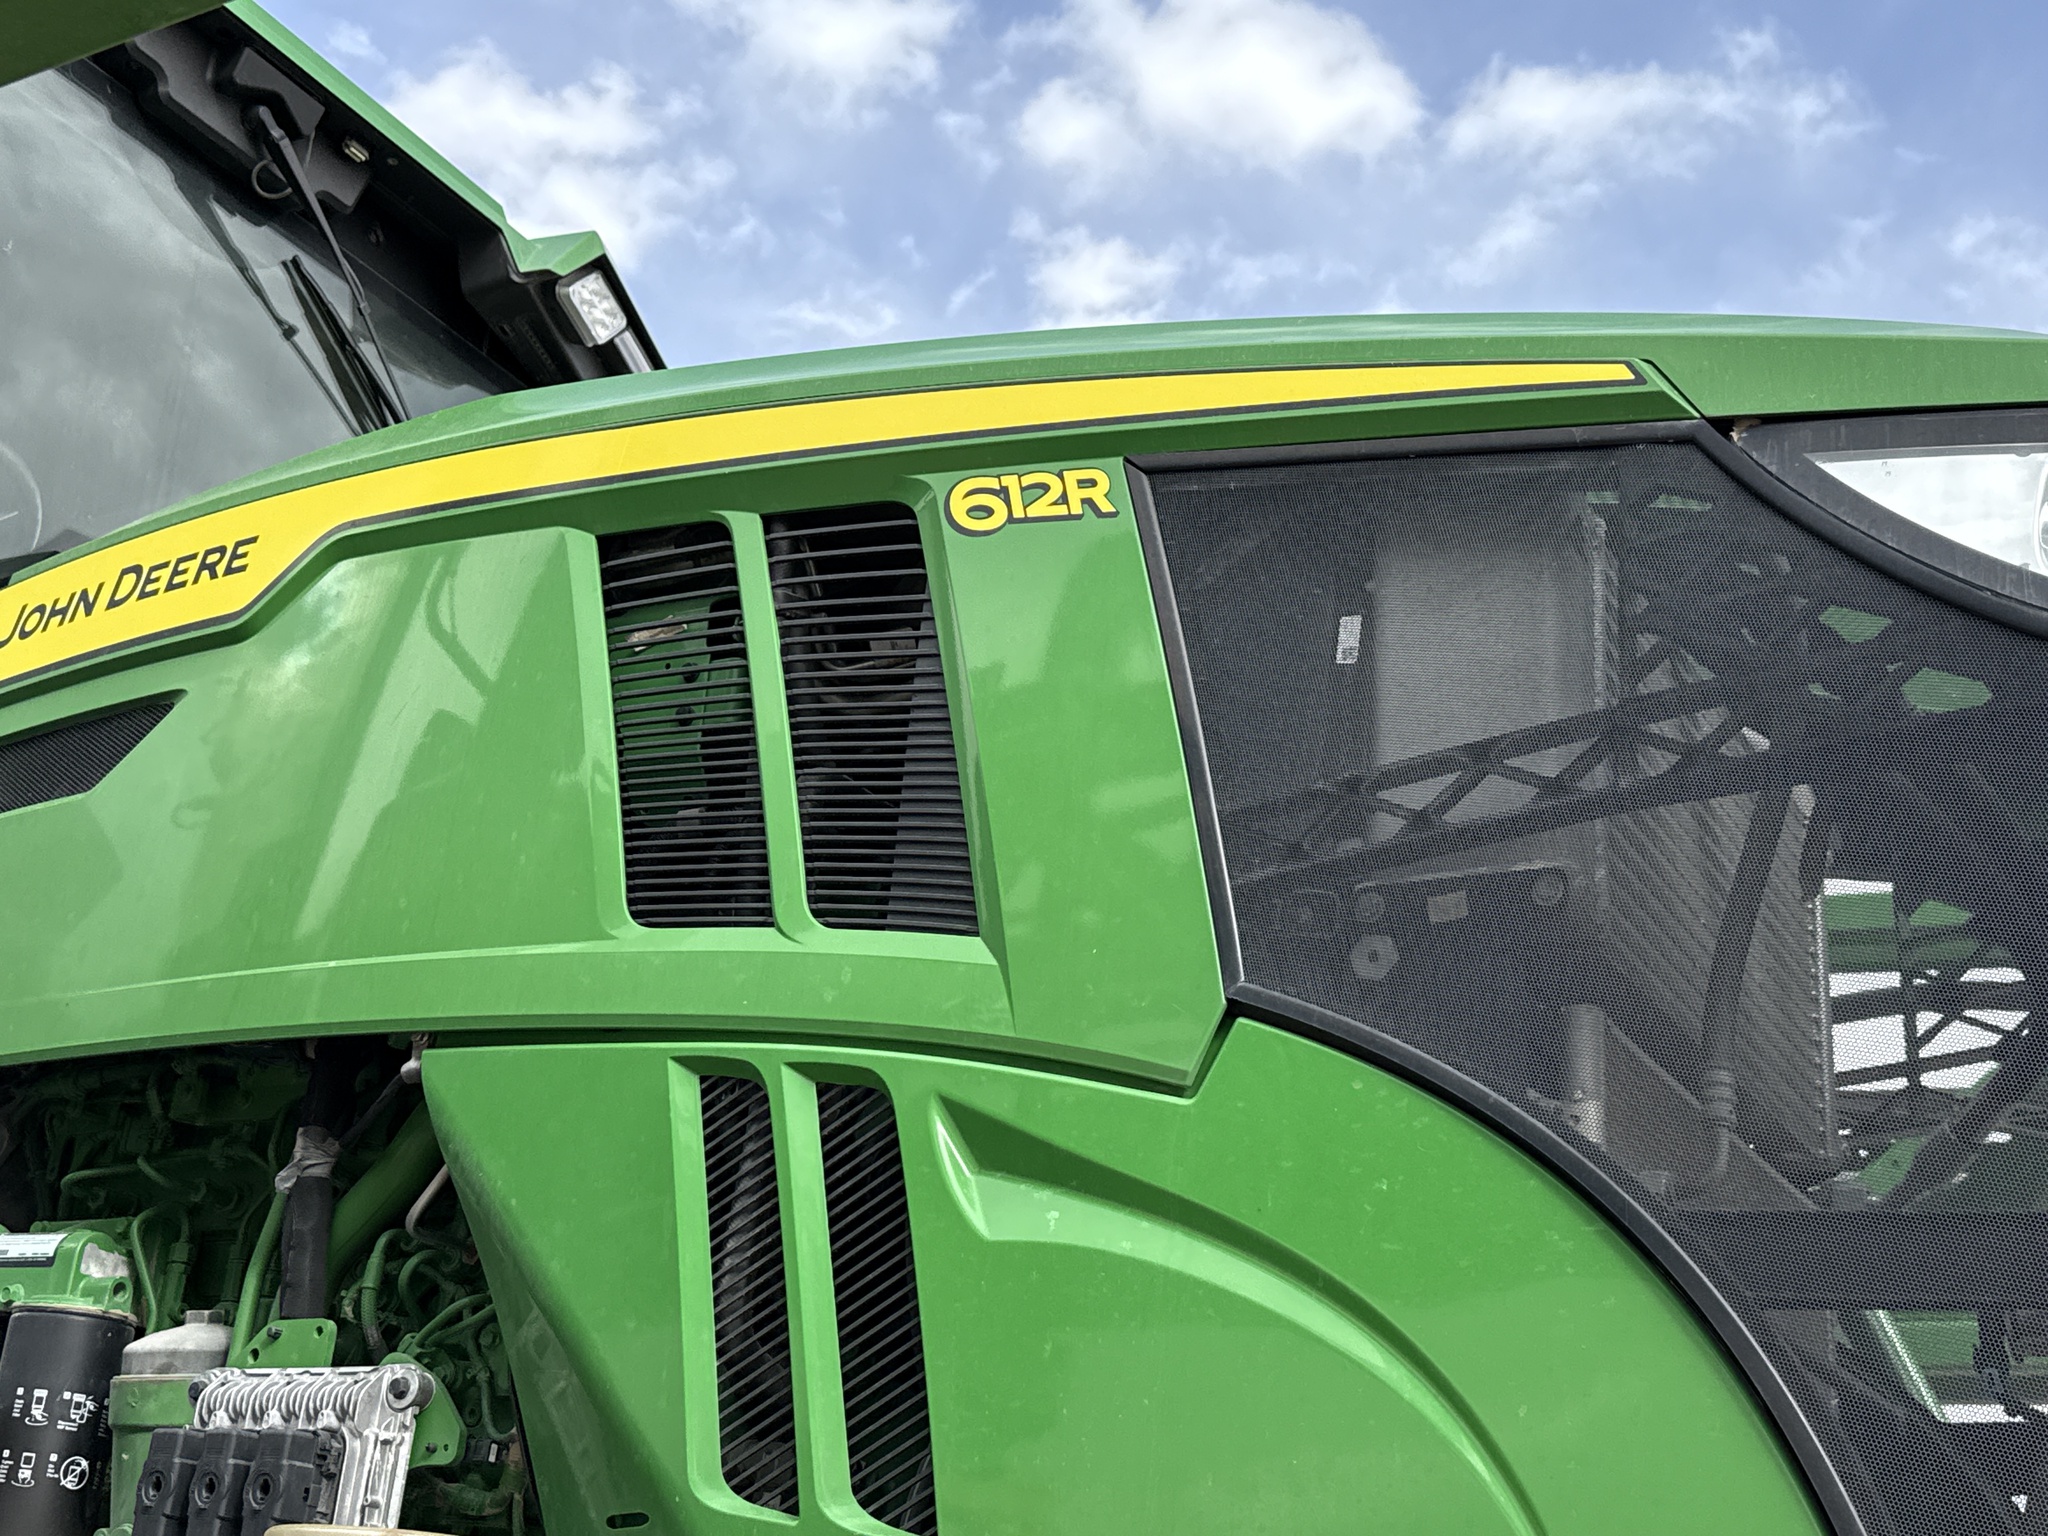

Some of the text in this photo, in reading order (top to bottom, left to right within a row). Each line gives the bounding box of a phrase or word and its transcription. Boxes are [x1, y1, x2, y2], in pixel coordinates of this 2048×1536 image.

[944, 467, 1120, 537] 612R
[0, 535, 260, 648] JOHN DEERE
